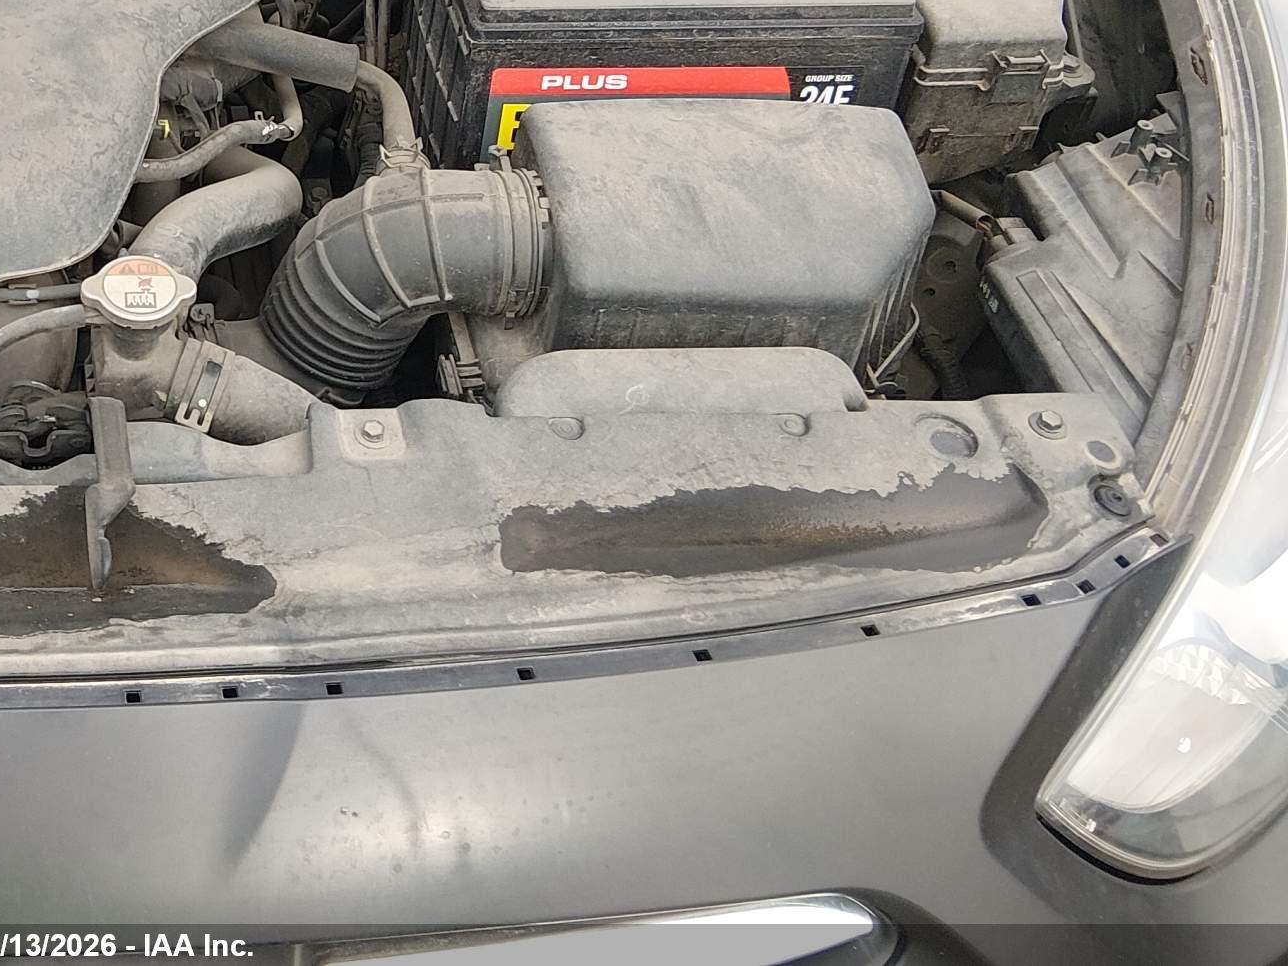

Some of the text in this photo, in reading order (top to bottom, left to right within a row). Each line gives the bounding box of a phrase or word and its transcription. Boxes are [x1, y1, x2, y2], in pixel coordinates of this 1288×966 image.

[540, 74, 628, 90] PLUS
[805, 74, 854, 82] GROUP SIZE
